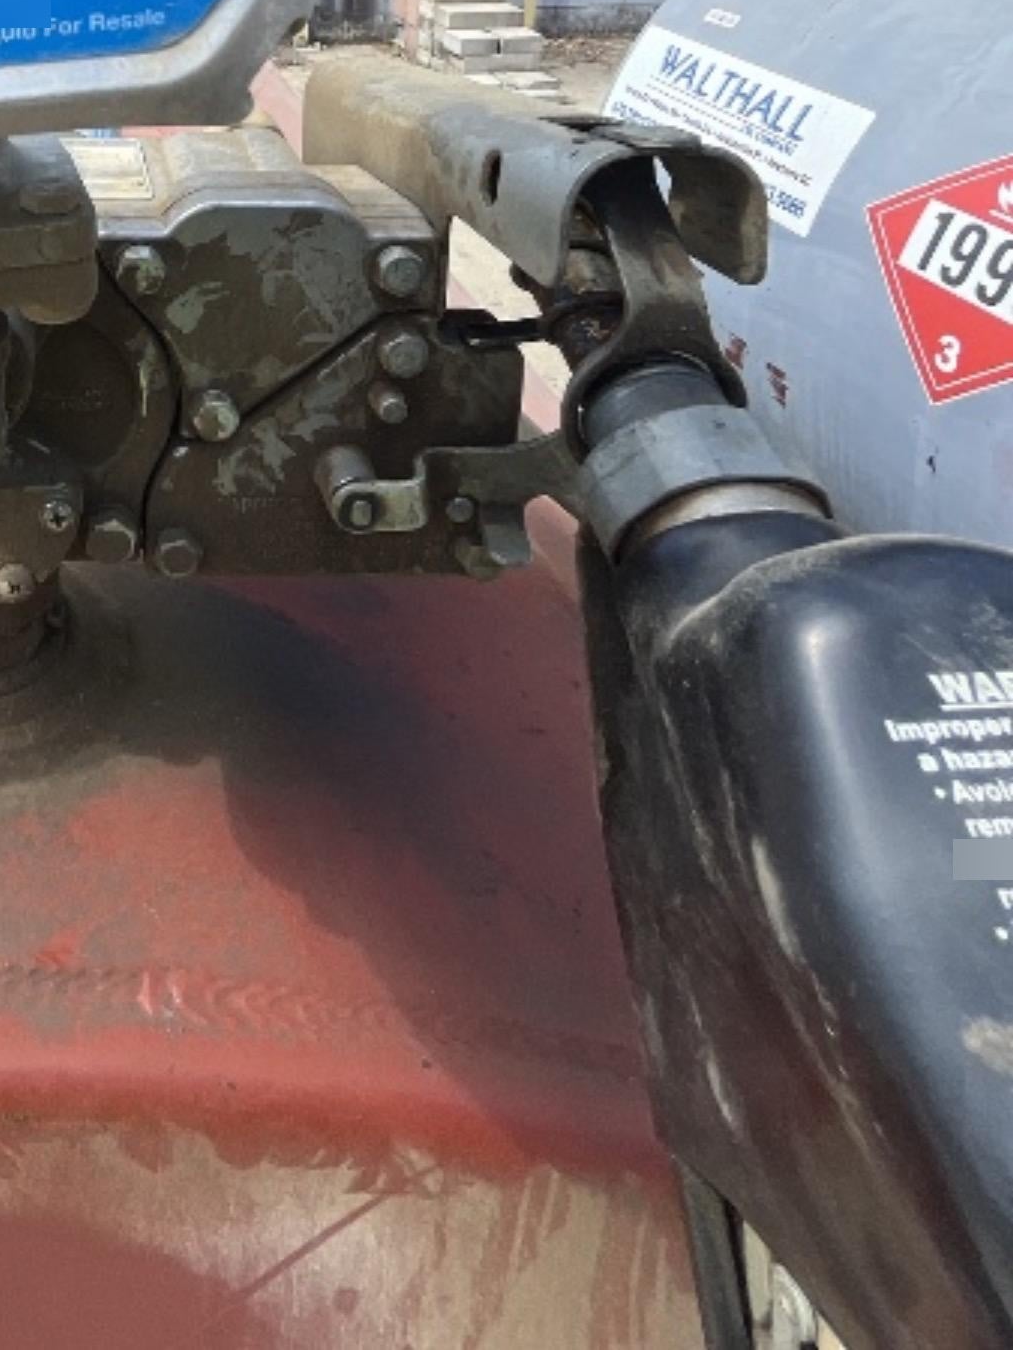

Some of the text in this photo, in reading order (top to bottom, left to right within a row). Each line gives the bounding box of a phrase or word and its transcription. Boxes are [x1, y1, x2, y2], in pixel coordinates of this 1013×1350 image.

[89, 8, 166, 33] Resale
[659, 44, 814, 143] WALTHALL
[917, 211, 1013, 307] 199
[934, 334, 961, 374] 3
